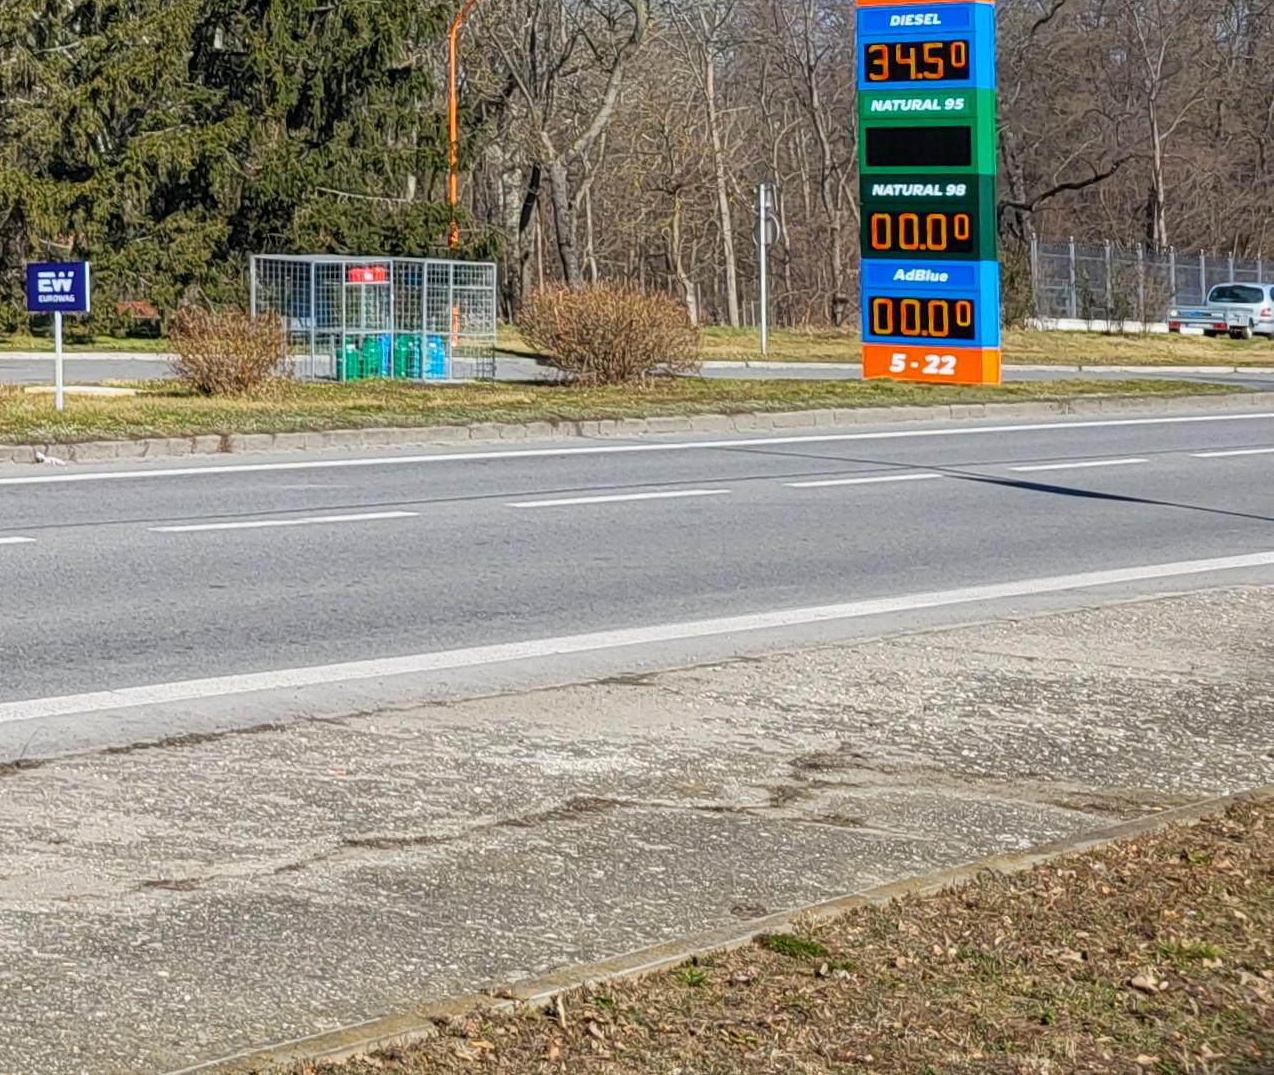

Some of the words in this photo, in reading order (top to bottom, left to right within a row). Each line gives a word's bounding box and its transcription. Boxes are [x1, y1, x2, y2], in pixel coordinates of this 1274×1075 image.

[890, 13, 941, 26] DIESEL
[871, 99, 941, 112] NATURAL
[945, 98, 964, 110] 95
[872, 184, 942, 196] NATURAL
[945, 184, 966, 196] 98
[38, 271, 74, 292] EW
[893, 268, 948, 282] AdBlue
[889, 353, 906, 373] 5
[922, 354, 956, 375] 22
